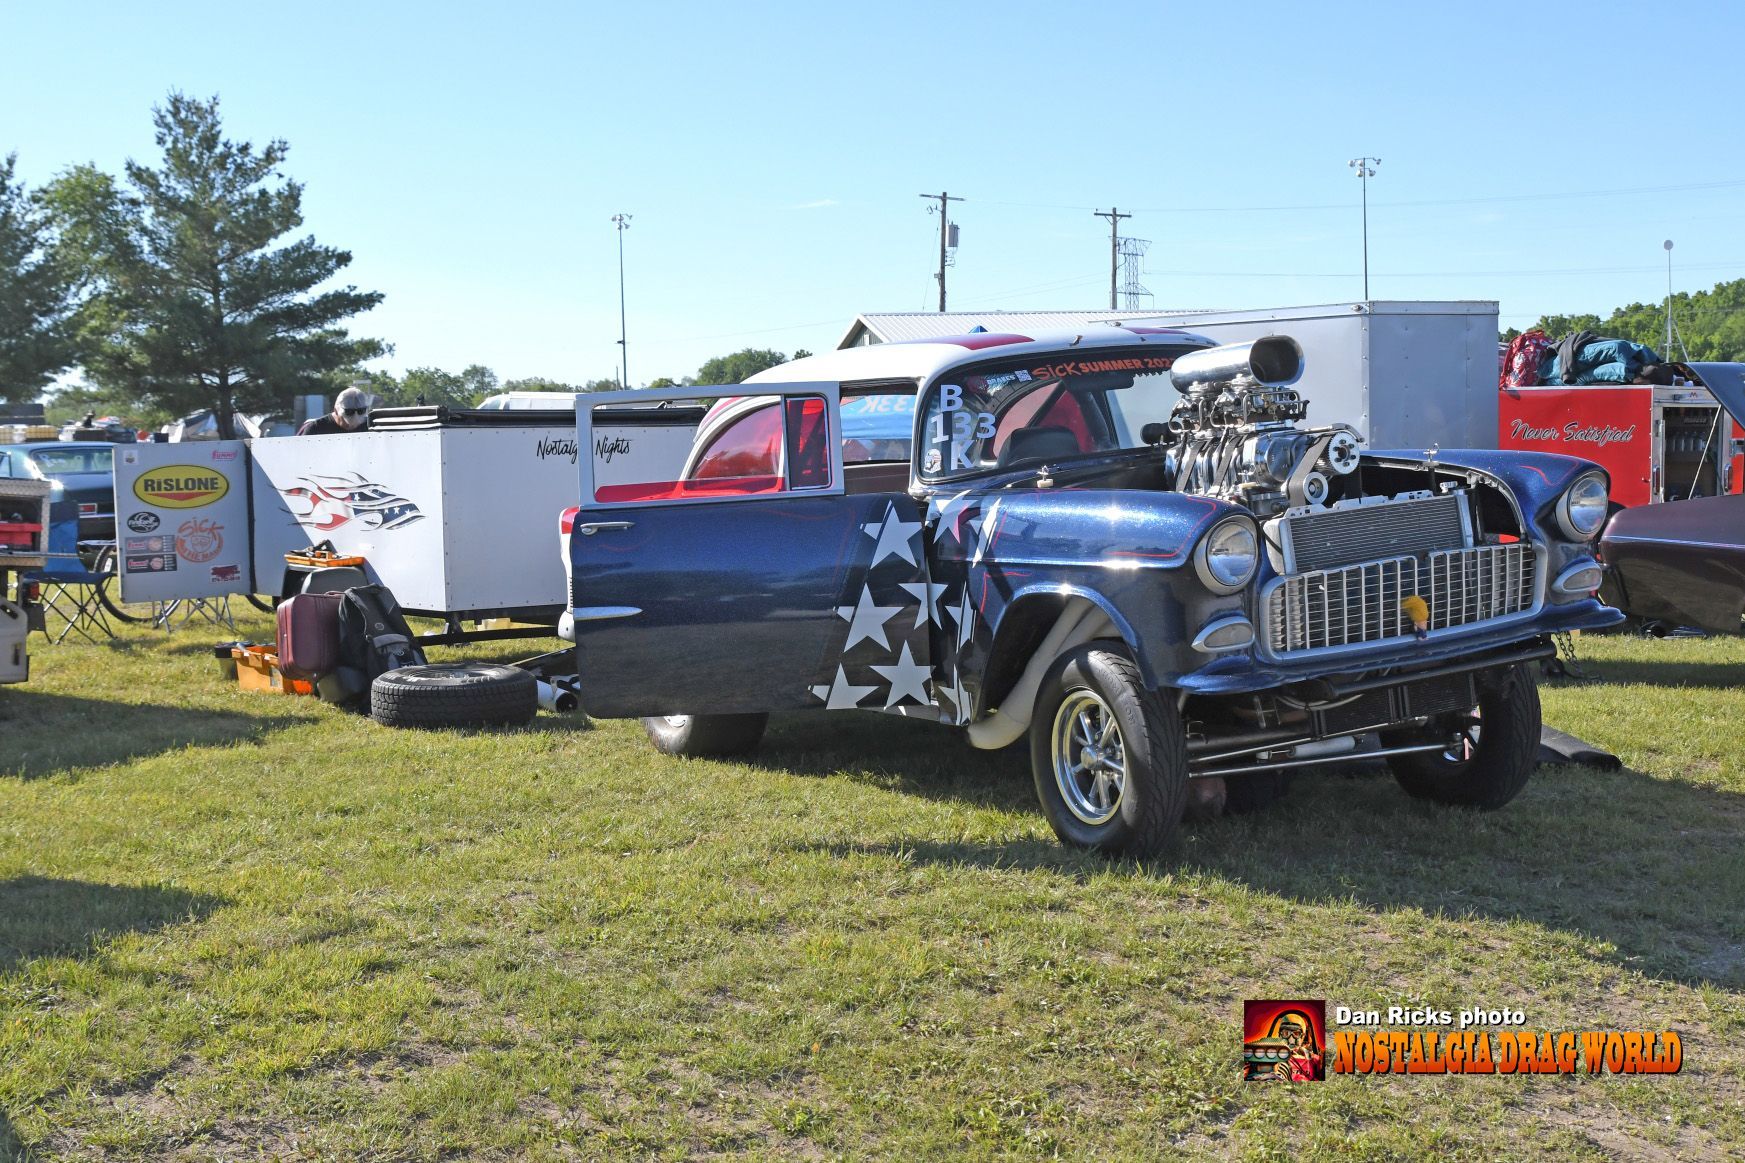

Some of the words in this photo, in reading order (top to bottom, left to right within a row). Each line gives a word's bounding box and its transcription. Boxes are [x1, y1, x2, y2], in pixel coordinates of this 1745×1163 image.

[1080, 359, 1146, 373] SUMMER
[1144, 357, 1176, 369] 202
[941, 384, 963, 413] B
[931, 412, 996, 444] 133
[1511, 419, 1560, 441] Never
[1563, 421, 1636, 447] Satisfied
[537, 436, 578, 464] Nostalg
[595, 435, 634, 464] Nights
[951, 440, 976, 471] K
